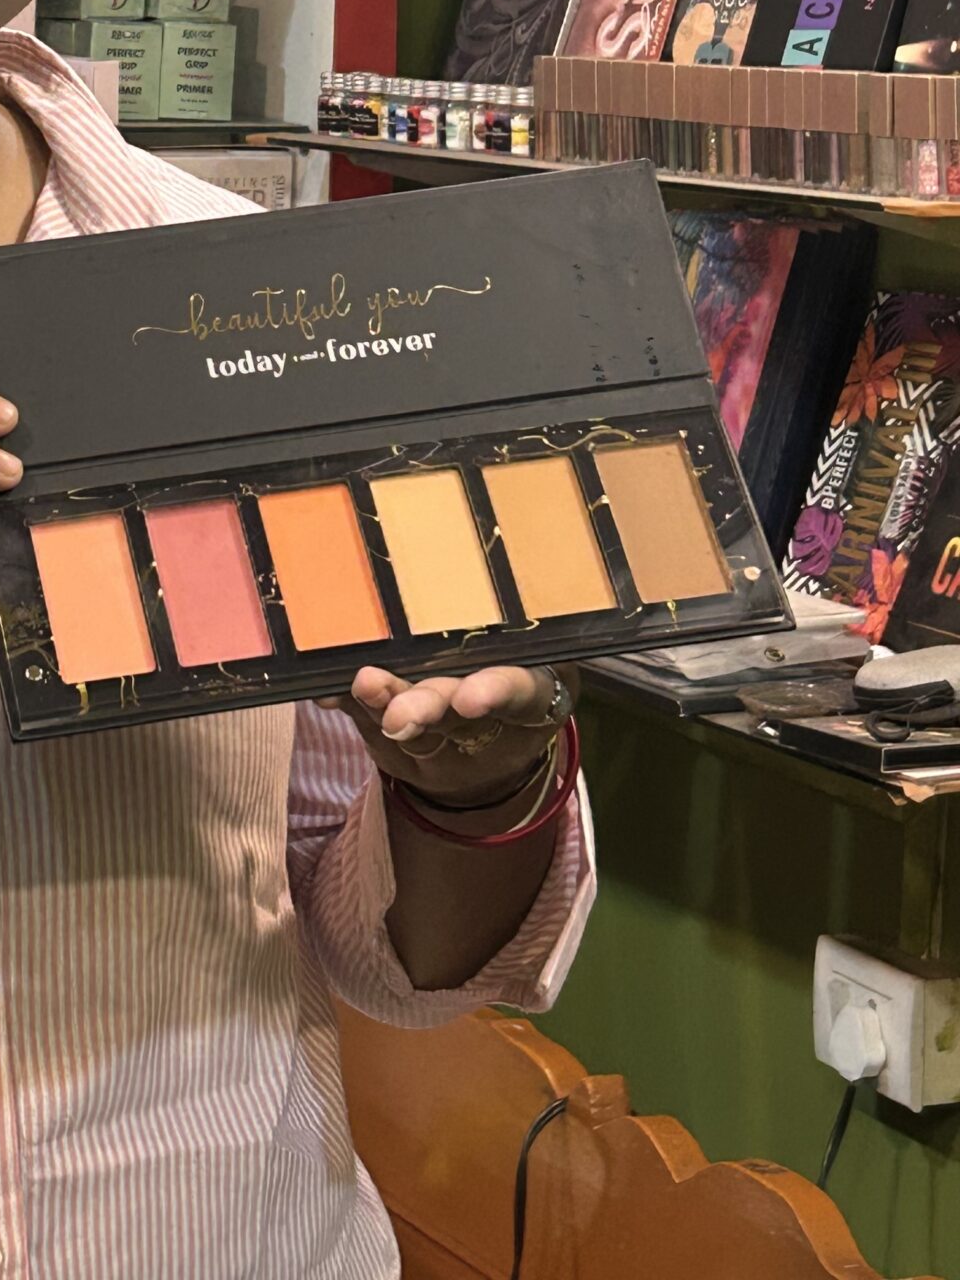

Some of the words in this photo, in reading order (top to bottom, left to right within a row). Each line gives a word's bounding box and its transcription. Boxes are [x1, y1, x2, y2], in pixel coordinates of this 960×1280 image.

[119, 61, 138, 71] RIP
[176, 84, 213, 95] PRIMER
[180, 272, 351, 341] beautiful
[367, 282, 452, 335] you
[206, 349, 287, 379] today
[325, 330, 438, 363] forever
[820, 428, 860, 509] BPERFECT
[827, 403, 918, 596] ARNIVAL
